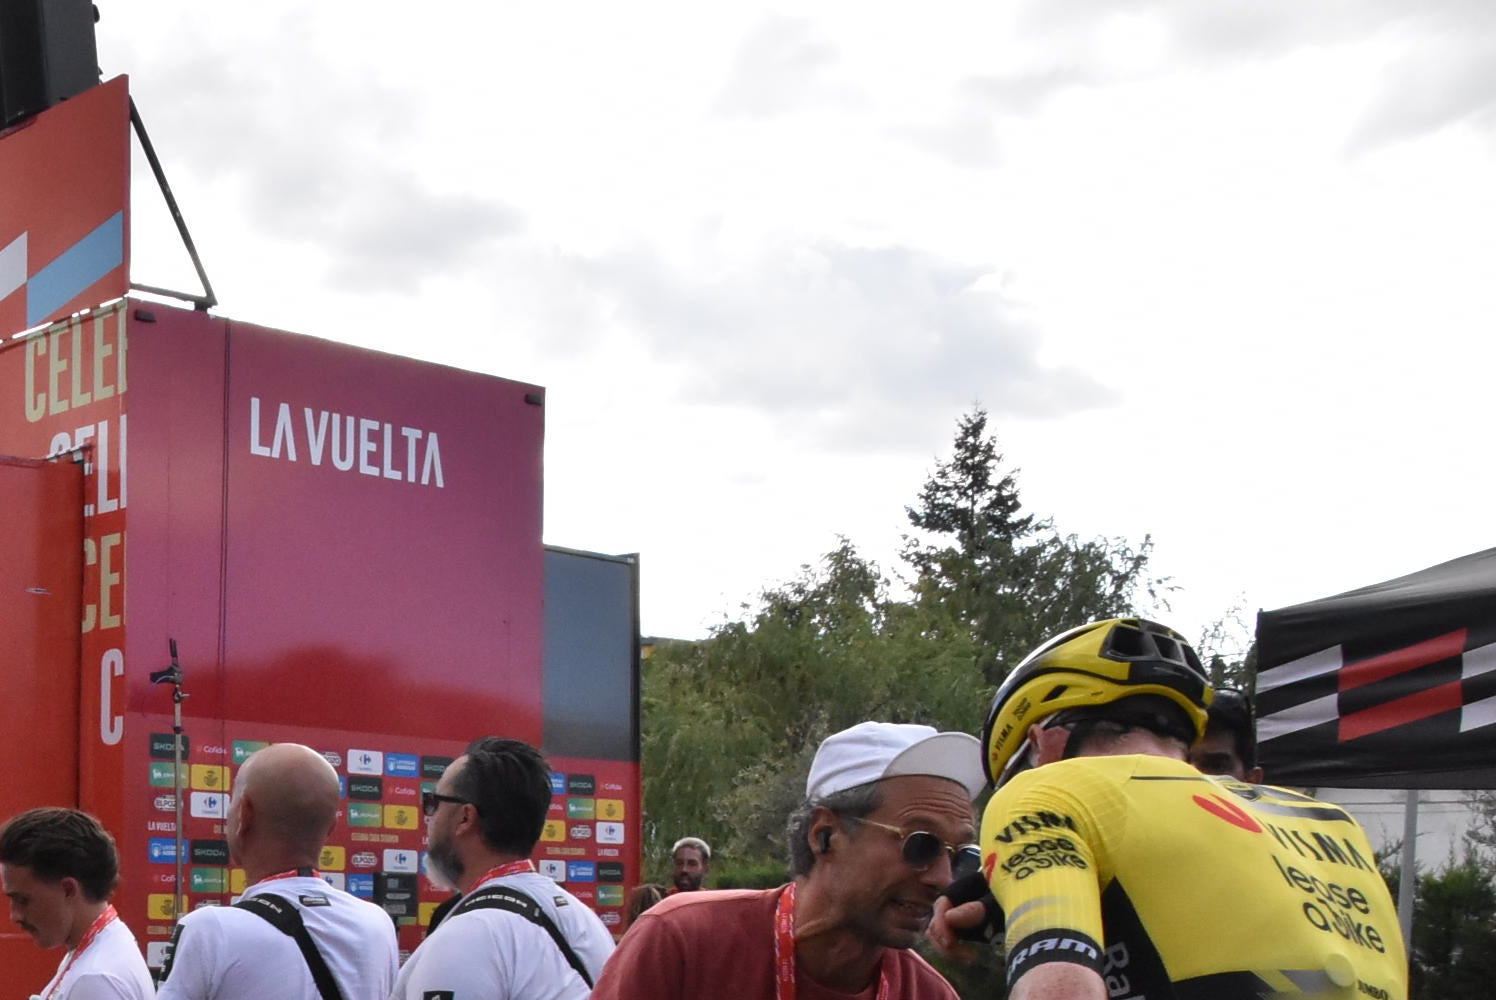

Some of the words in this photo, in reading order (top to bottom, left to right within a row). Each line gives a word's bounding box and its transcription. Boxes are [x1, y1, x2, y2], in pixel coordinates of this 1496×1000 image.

[250, 397, 297, 461] LA
[304, 407, 444, 488] VUELTA
[994, 811, 1078, 844] VISMA
[1258, 818, 1374, 873] VISMA
[1001, 838, 1077, 873] lease
[1272, 854, 1371, 914] lease
